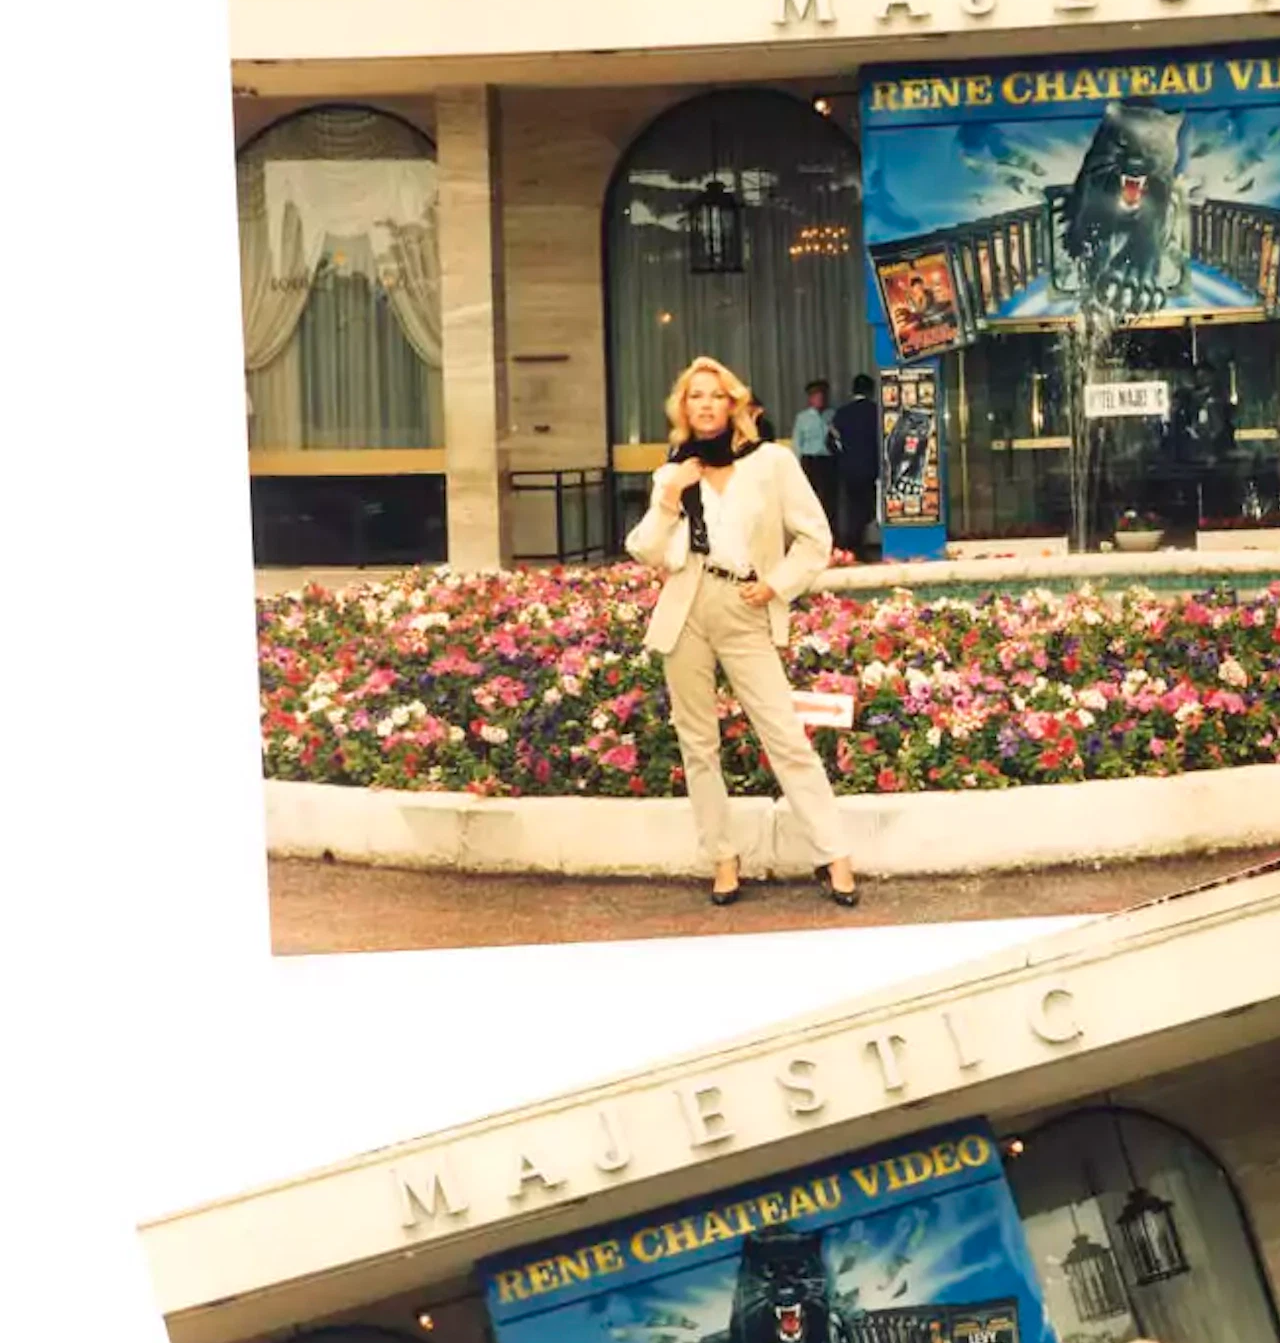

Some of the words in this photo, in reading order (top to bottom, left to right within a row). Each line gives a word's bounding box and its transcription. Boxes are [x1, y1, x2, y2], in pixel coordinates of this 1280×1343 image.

[869, 74, 992, 112] RENE
[1002, 61, 1213, 105] CHATEAU
[391, 988, 1084, 1231] MAJESTIC
[495, 1241, 622, 1303] RENE
[630, 1175, 842, 1262] CHATEAU
[850, 1134, 991, 1198] VIDEO
